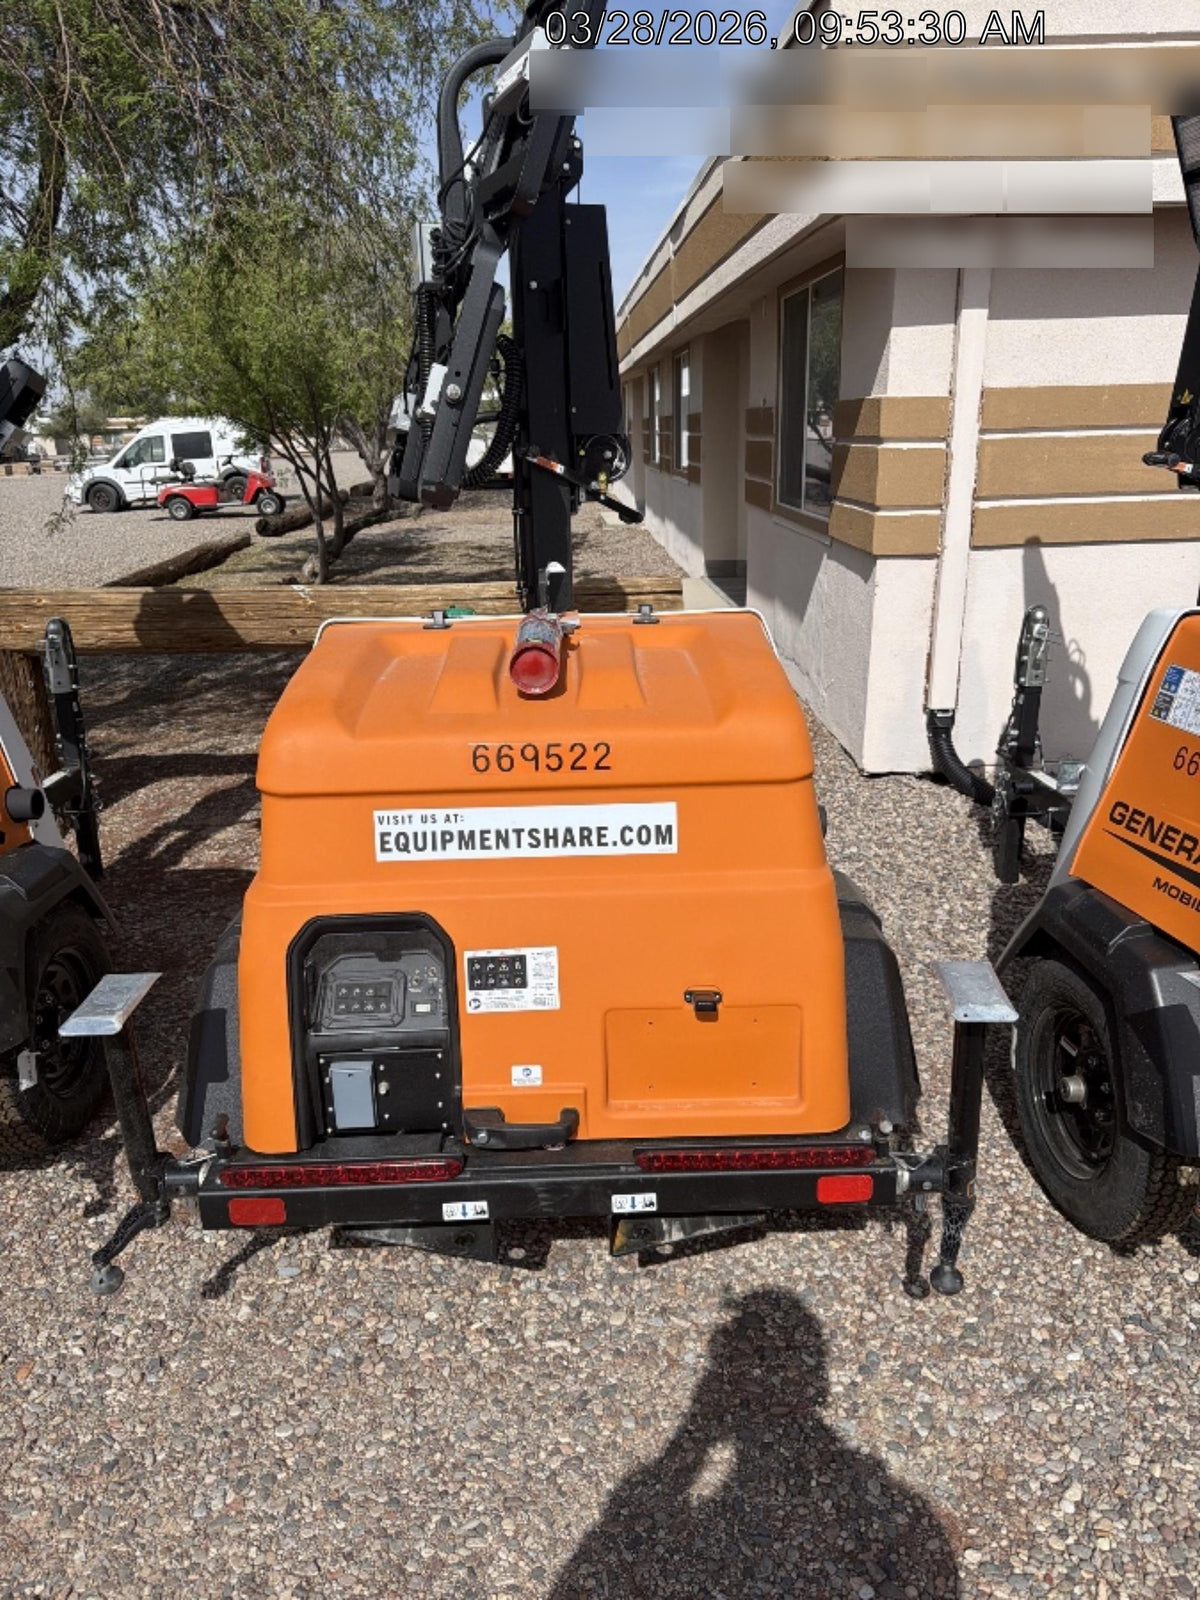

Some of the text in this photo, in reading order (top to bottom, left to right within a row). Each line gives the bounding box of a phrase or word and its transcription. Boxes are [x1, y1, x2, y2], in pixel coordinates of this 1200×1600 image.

[472, 742, 611, 772] 669522
[377, 813, 465, 826] VISIT US AT:
[379, 824, 673, 854] EQUIPMENTSHARE.COM
